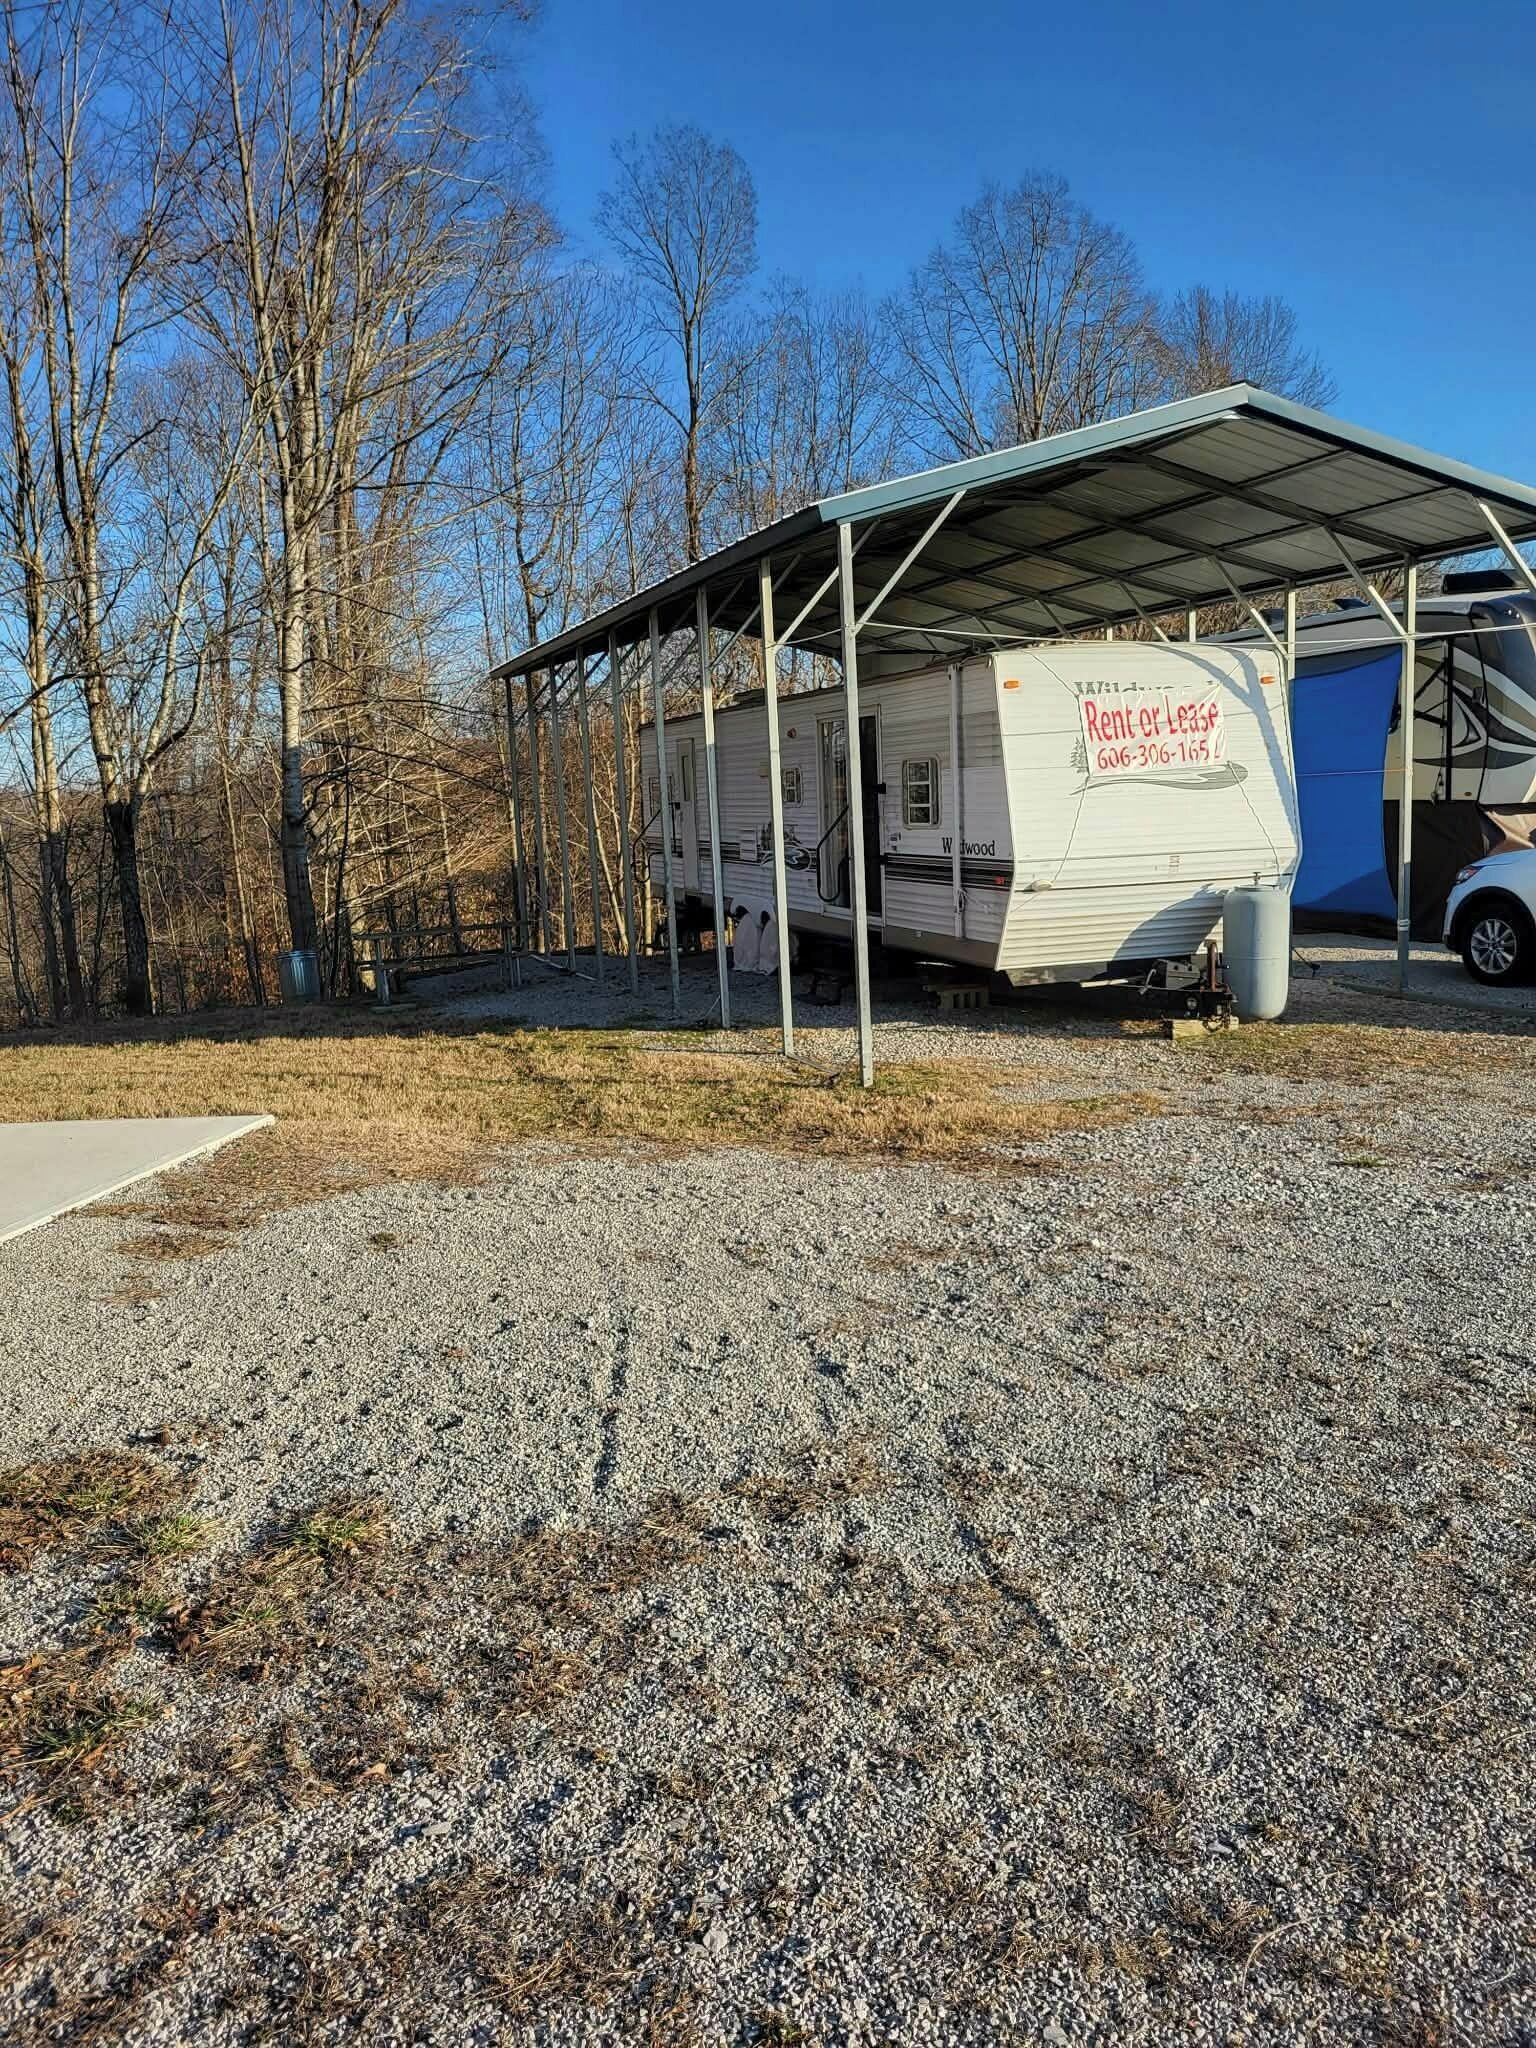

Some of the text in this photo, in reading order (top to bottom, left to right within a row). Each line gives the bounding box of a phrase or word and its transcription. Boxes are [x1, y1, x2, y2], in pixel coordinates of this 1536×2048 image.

[1084, 694, 1219, 743] Rent or Lease
[941, 836, 995, 857] Wdwood
